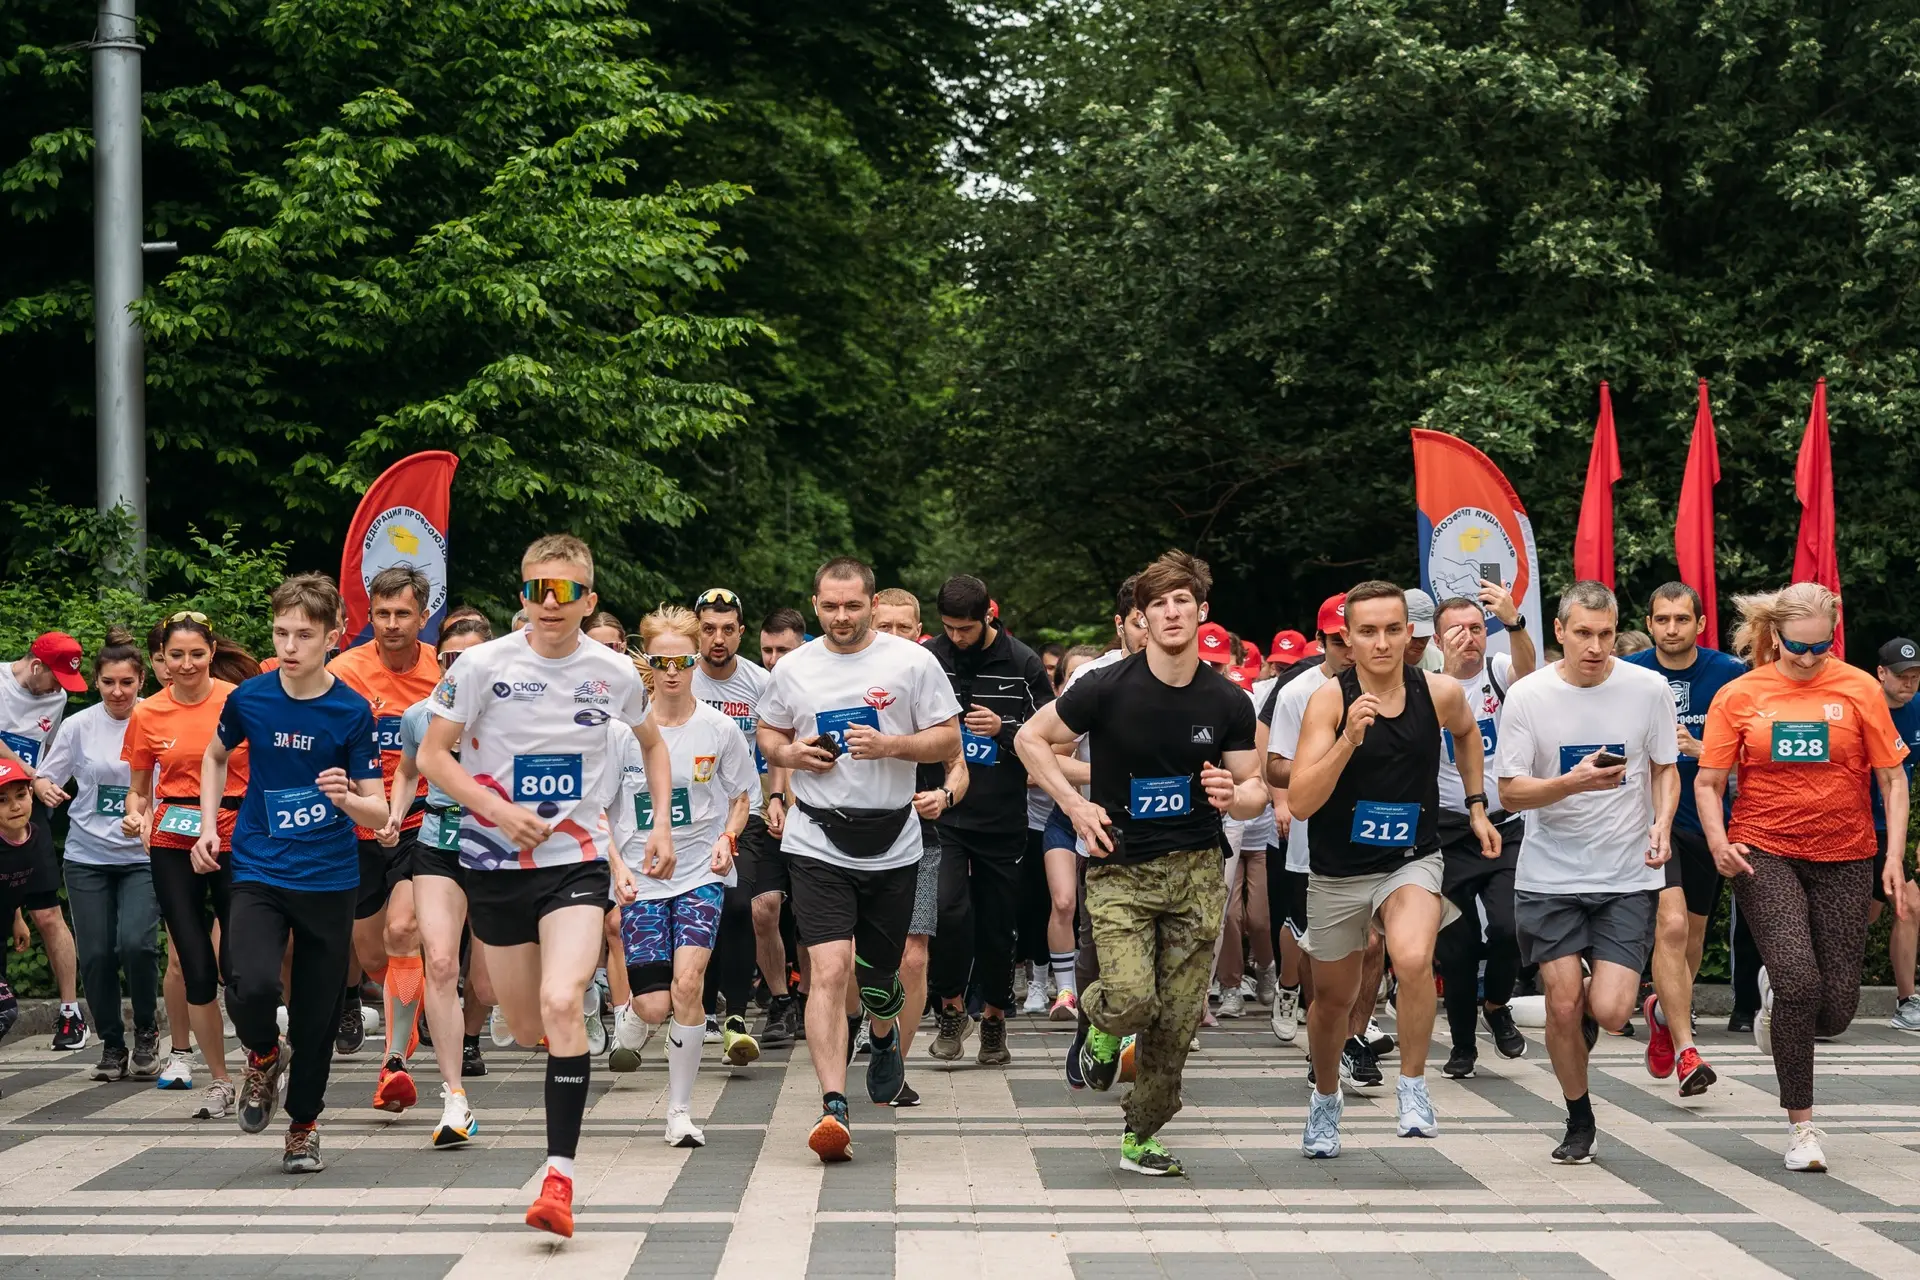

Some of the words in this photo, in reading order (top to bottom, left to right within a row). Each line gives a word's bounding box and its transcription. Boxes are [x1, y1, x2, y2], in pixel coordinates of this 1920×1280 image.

[364, 507, 403, 551] ФЕДЕРАЦИЯ
[430, 585, 448, 611] КРАЯ
[512, 682, 548, 692] СКФУ
[573, 697, 610, 705] TRIATHLON
[1777, 738, 1824, 757] 828
[520, 774, 575, 796] 800
[102, 798, 126, 814] 24
[1138, 793, 1184, 813] 720
[276, 803, 328, 830] 269
[642, 804, 685, 826] 75
[1359, 819, 1410, 841] 212
[553, 1075, 584, 1084] TORRES
